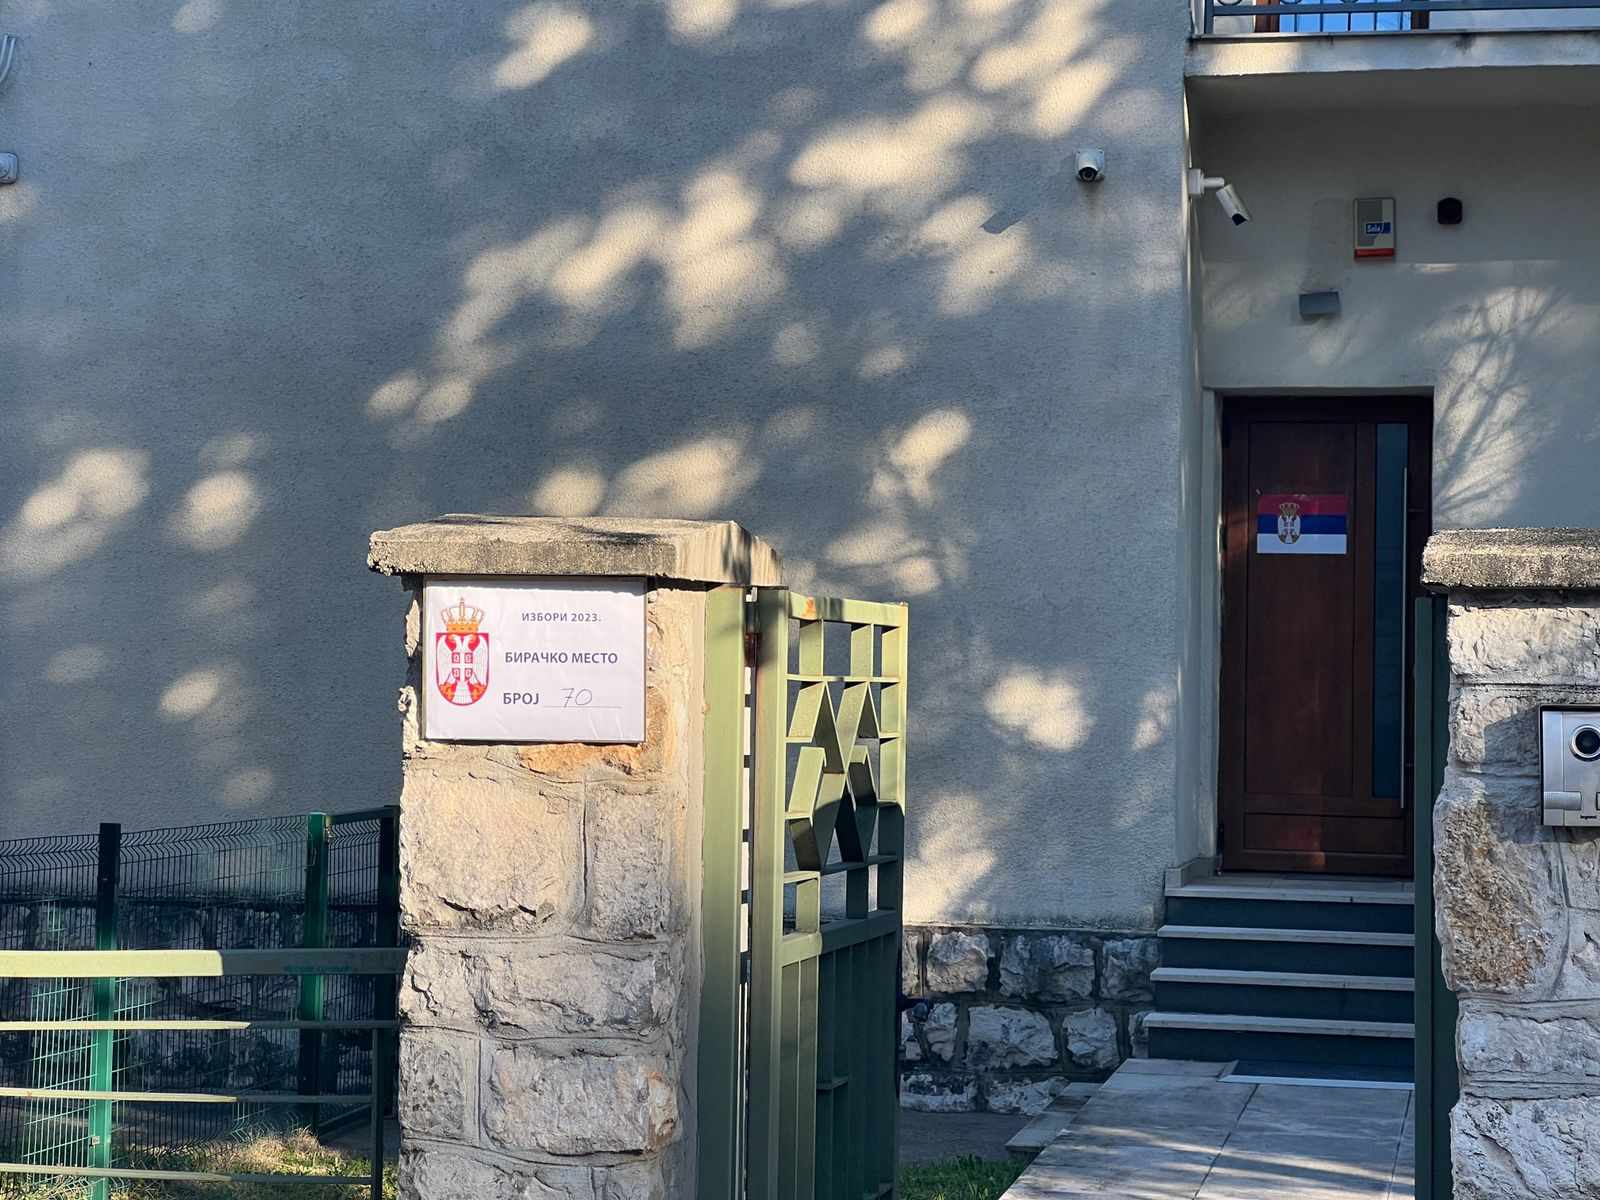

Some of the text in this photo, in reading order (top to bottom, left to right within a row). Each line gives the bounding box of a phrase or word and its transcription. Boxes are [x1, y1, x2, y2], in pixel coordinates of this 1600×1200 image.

[521, 612, 602, 622] ИЗБОРИ 2023.
[505, 651, 618, 664] БИРАЧКО МЕСТО
[503, 687, 593, 709] БРОЈ 70
